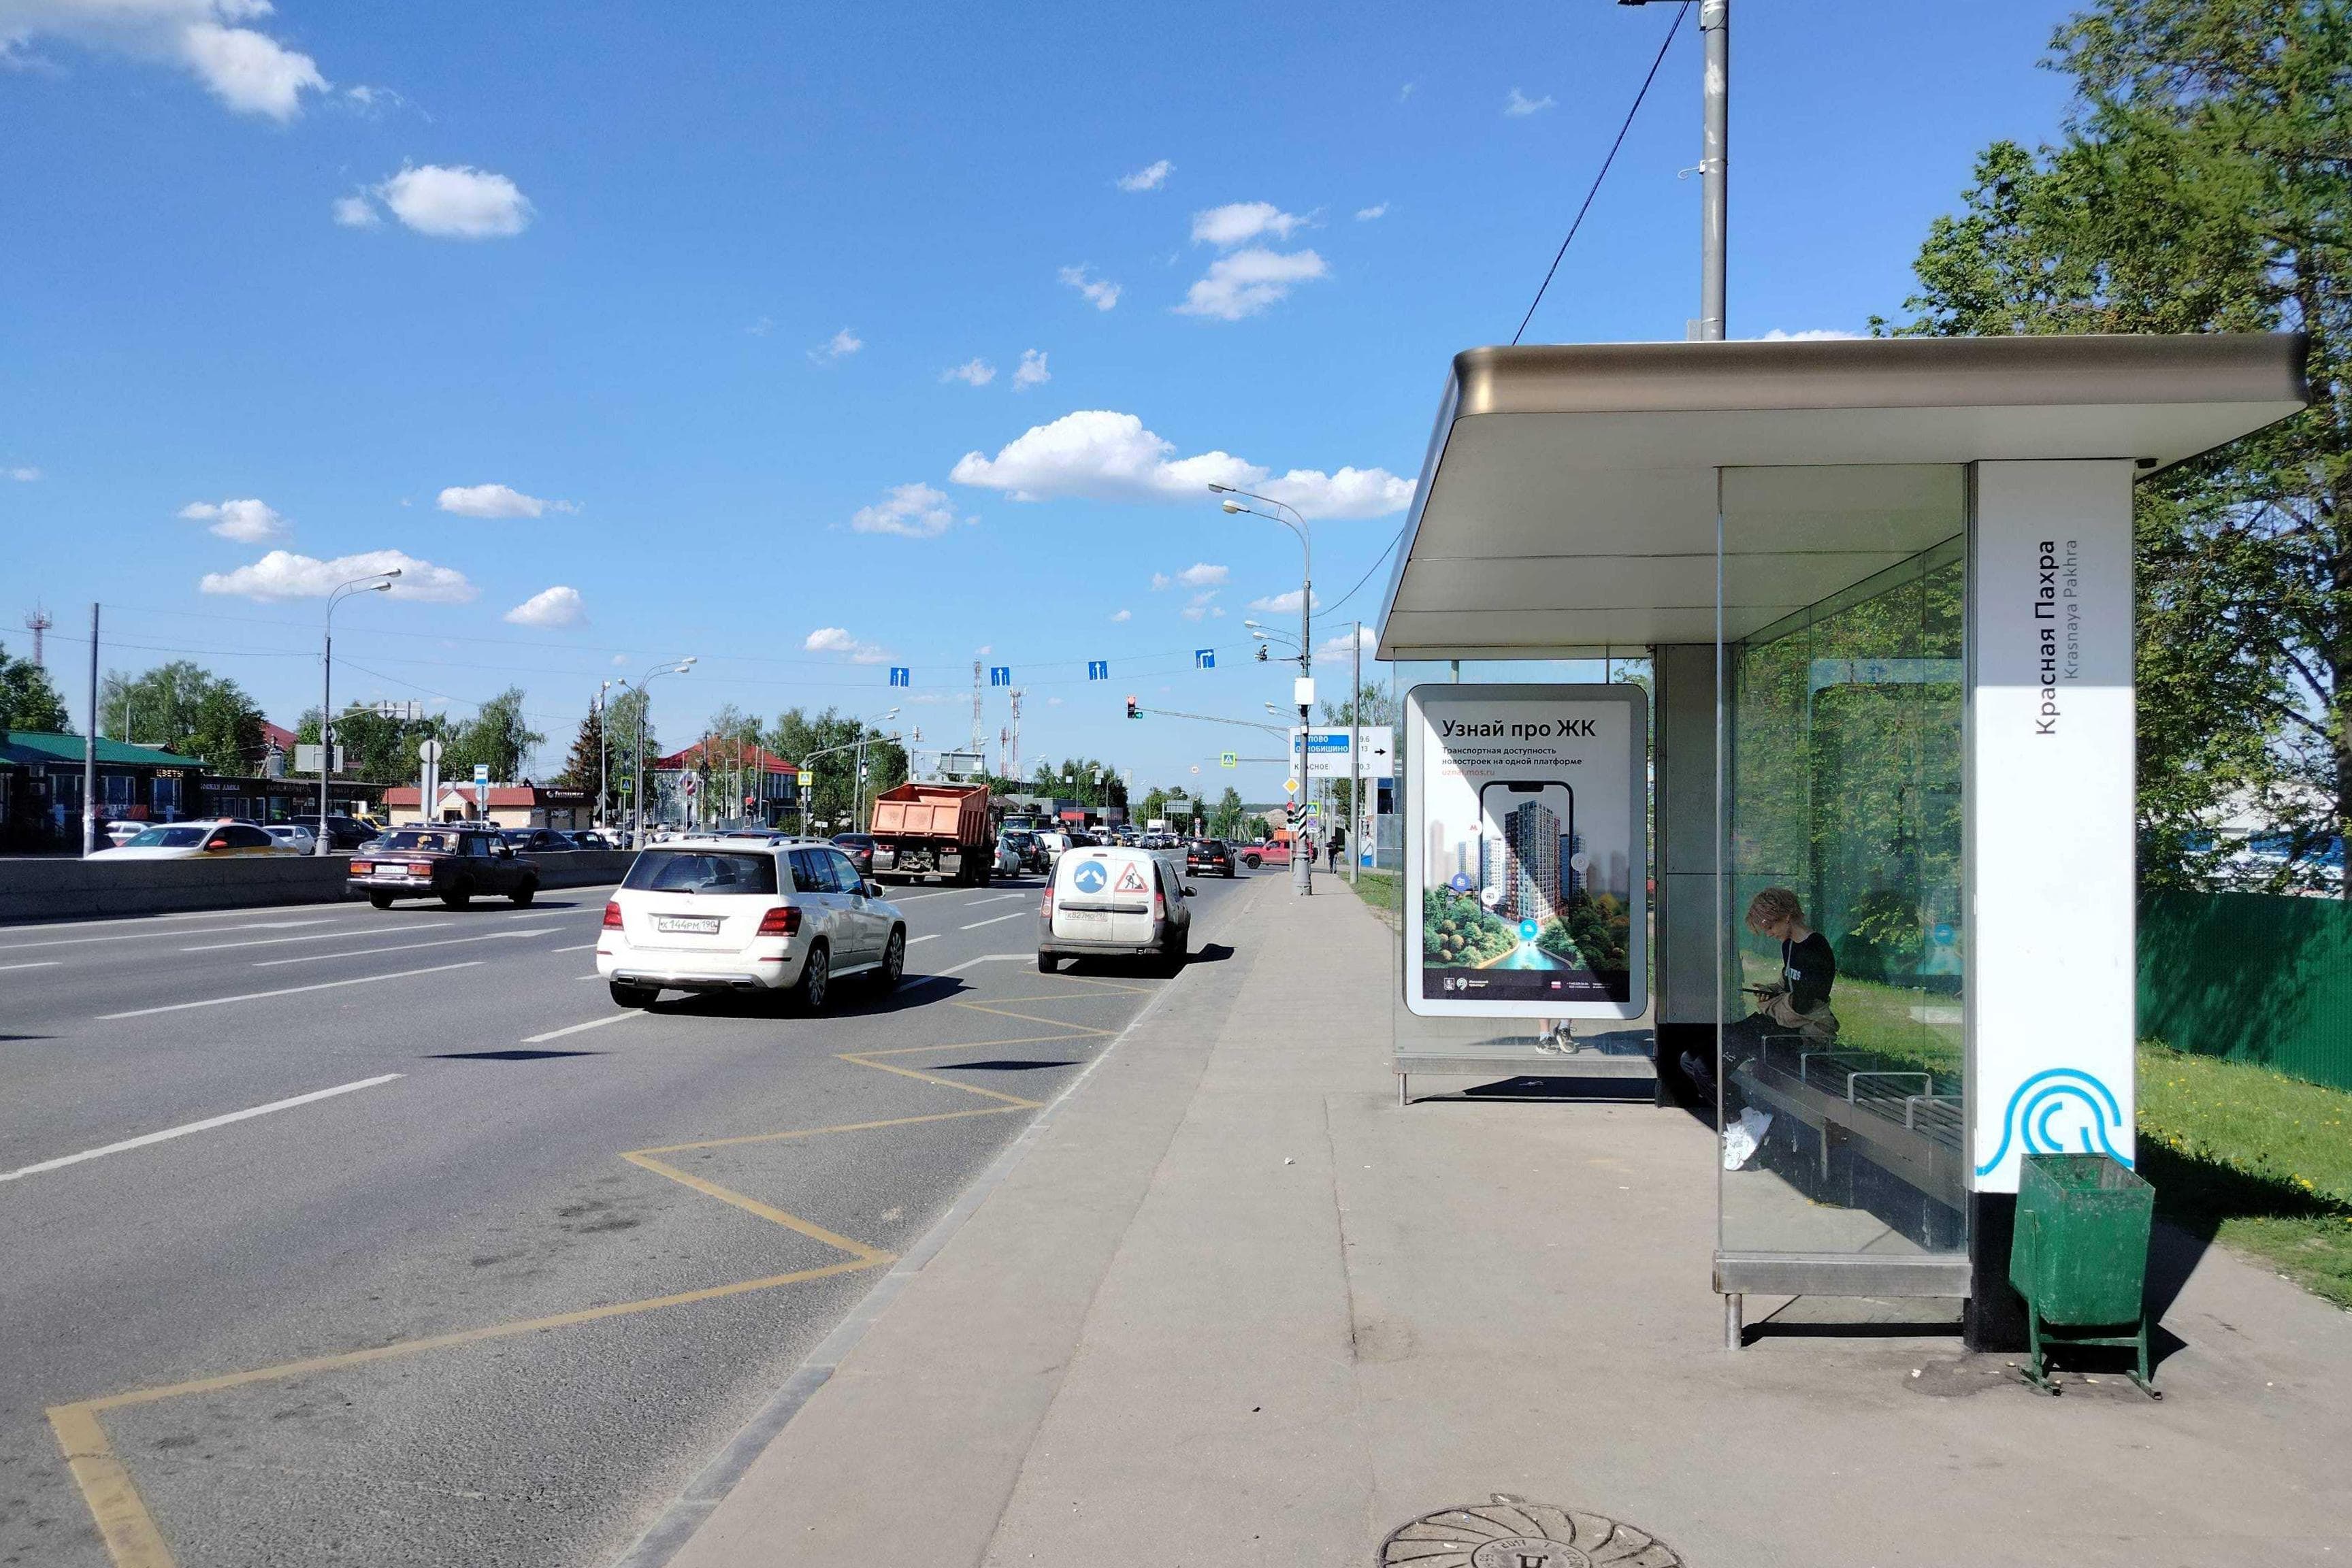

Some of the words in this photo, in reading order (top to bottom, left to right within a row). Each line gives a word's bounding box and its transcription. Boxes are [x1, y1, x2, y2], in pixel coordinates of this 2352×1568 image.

[2034, 541, 2059, 619] Пахра
[2063, 540, 2078, 598] Pakhra
[2064, 604, 2080, 679] Krasnaya
[2036, 629, 2061, 735] Красная
[1442, 719, 1505, 737] Узнай
[1512, 723, 1552, 741] про
[1556, 719, 1597, 737] ЖК
[1442, 747, 1502, 755] Транспортная
[1503, 748, 1557, 756] доступность
[1442, 758, 1492, 766] новостроек
[1505, 757, 1532, 766] одной
[1533, 757, 1583, 767] платформе
[156, 769, 184, 778] ЦВЕТЫ
